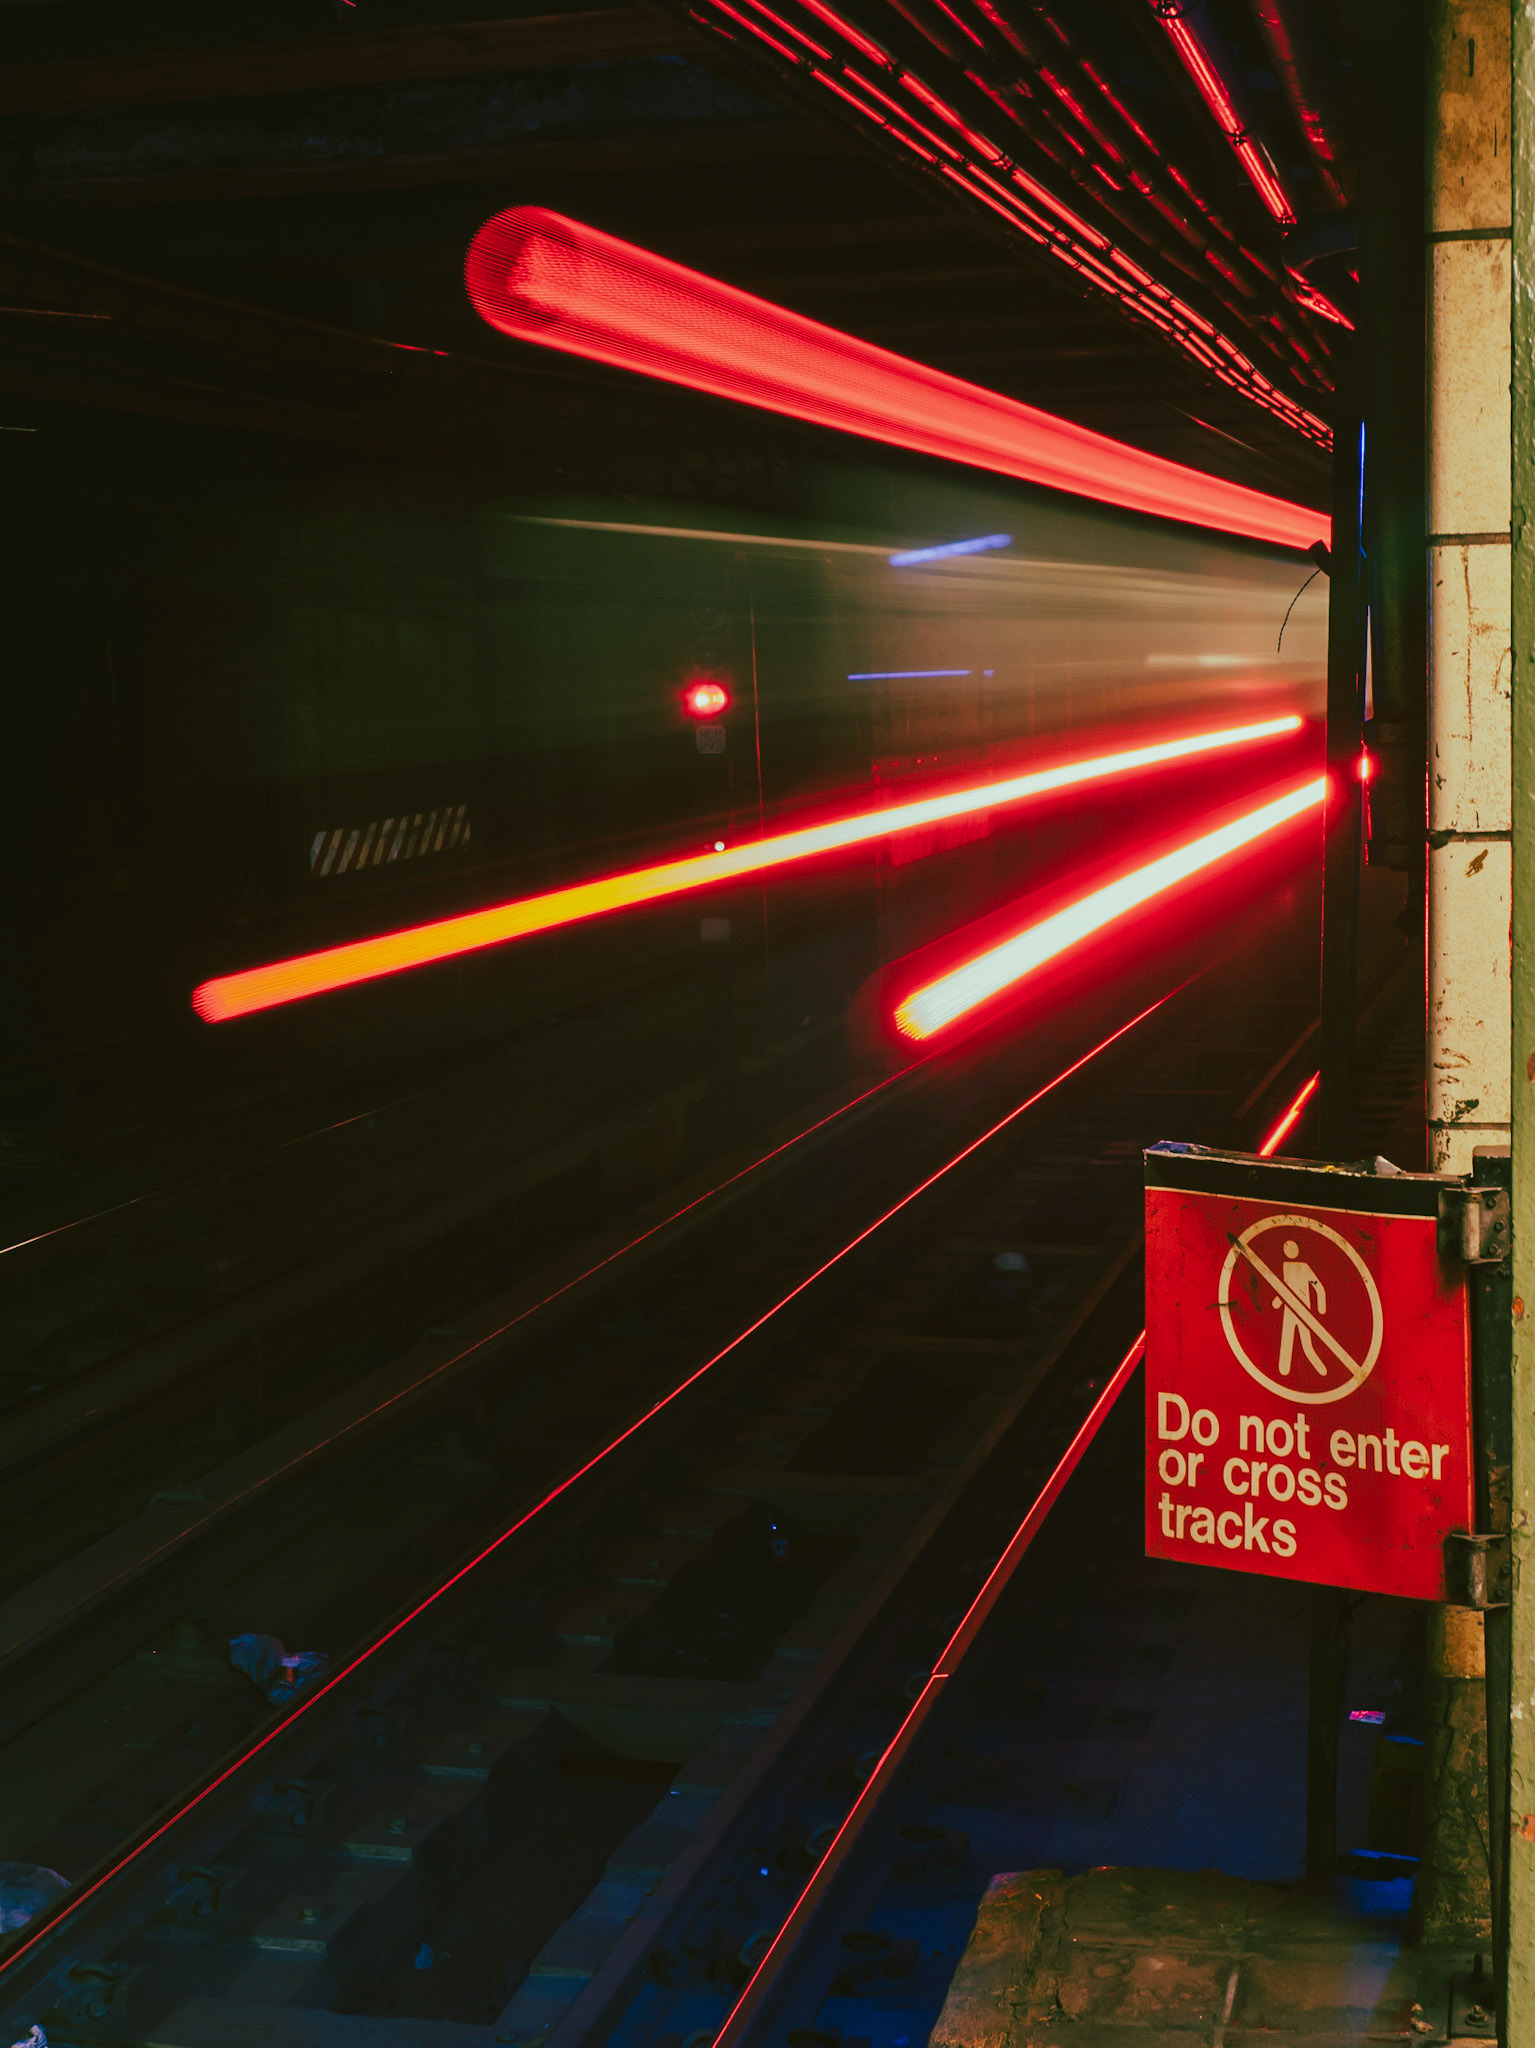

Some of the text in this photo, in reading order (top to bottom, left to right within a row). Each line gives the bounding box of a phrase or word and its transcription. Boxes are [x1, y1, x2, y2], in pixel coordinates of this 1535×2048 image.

[1158, 1391, 1450, 1481] Do not enter
[1158, 1448, 1349, 1511] or cross
[1157, 1492, 1297, 1558] tracks
